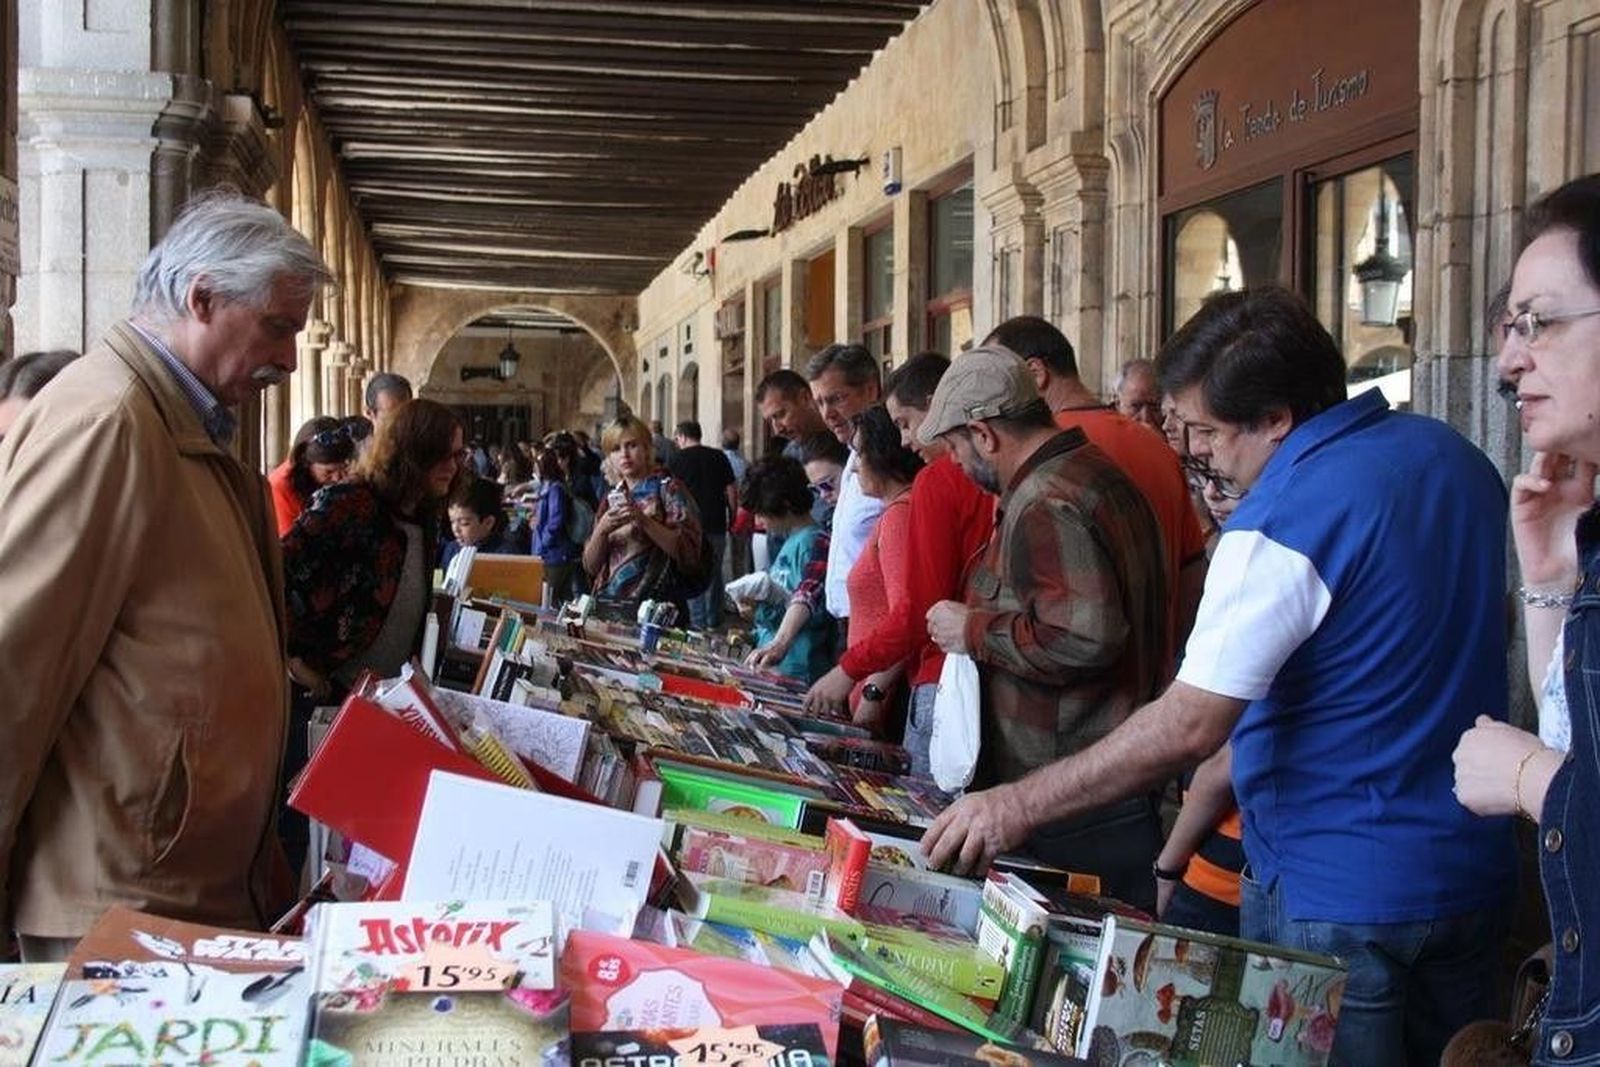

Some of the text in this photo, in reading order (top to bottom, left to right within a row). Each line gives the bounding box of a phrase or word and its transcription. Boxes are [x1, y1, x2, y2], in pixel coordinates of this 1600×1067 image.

[1289, 89, 1306, 122] de
[1311, 67, 1369, 112] Turismo
[416, 964, 498, 989] 15'95
[363, 1038, 521, 1053] MINERALES
[1188, 1010, 1206, 1051] SETAS
